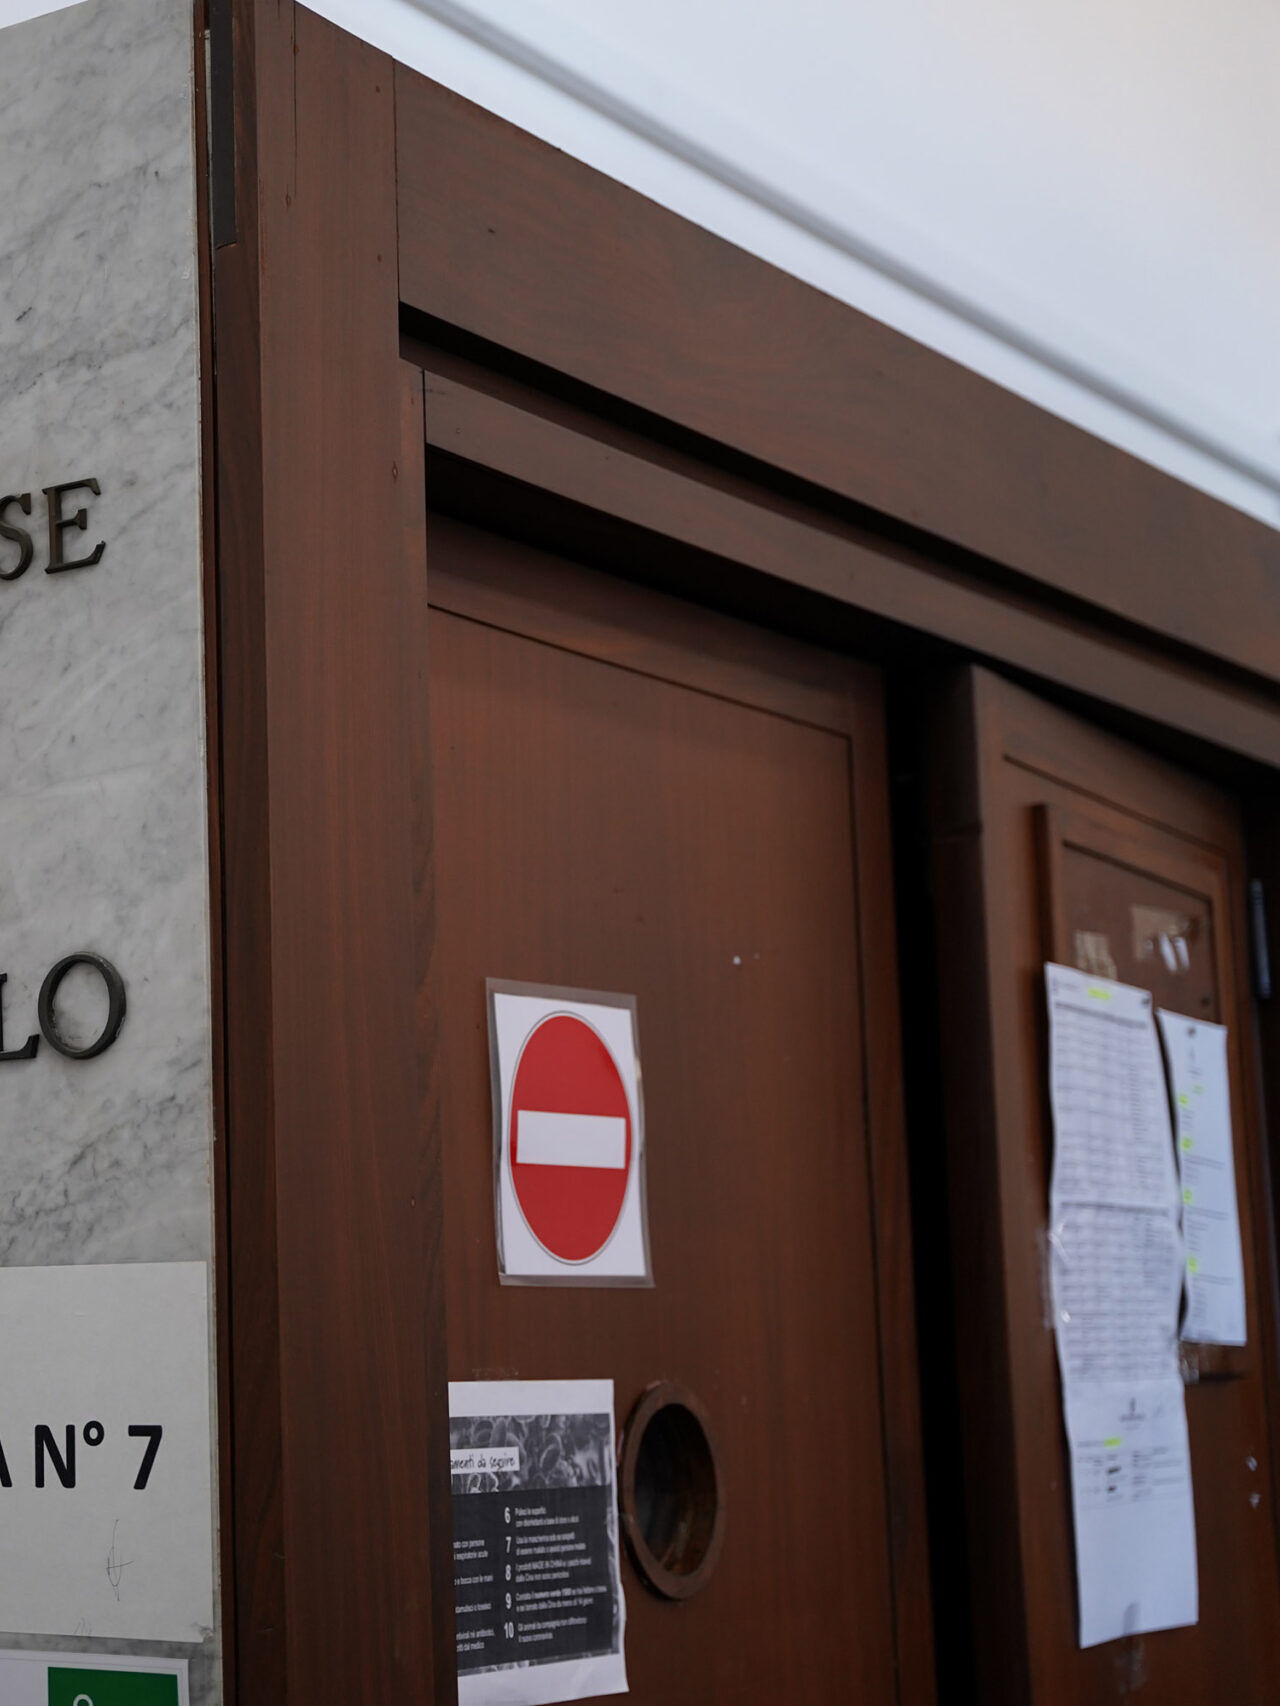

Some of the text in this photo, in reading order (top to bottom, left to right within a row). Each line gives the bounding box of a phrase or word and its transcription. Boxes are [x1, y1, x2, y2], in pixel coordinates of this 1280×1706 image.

[34, 1420, 105, 1489] N°
[128, 1425, 163, 1491] 7
[504, 1506, 511, 1524] 6
[505, 1536, 512, 1553] 7
[505, 1564, 512, 1581] 8
[505, 1592, 512, 1609] 9
[503, 1621, 514, 1639] 10
